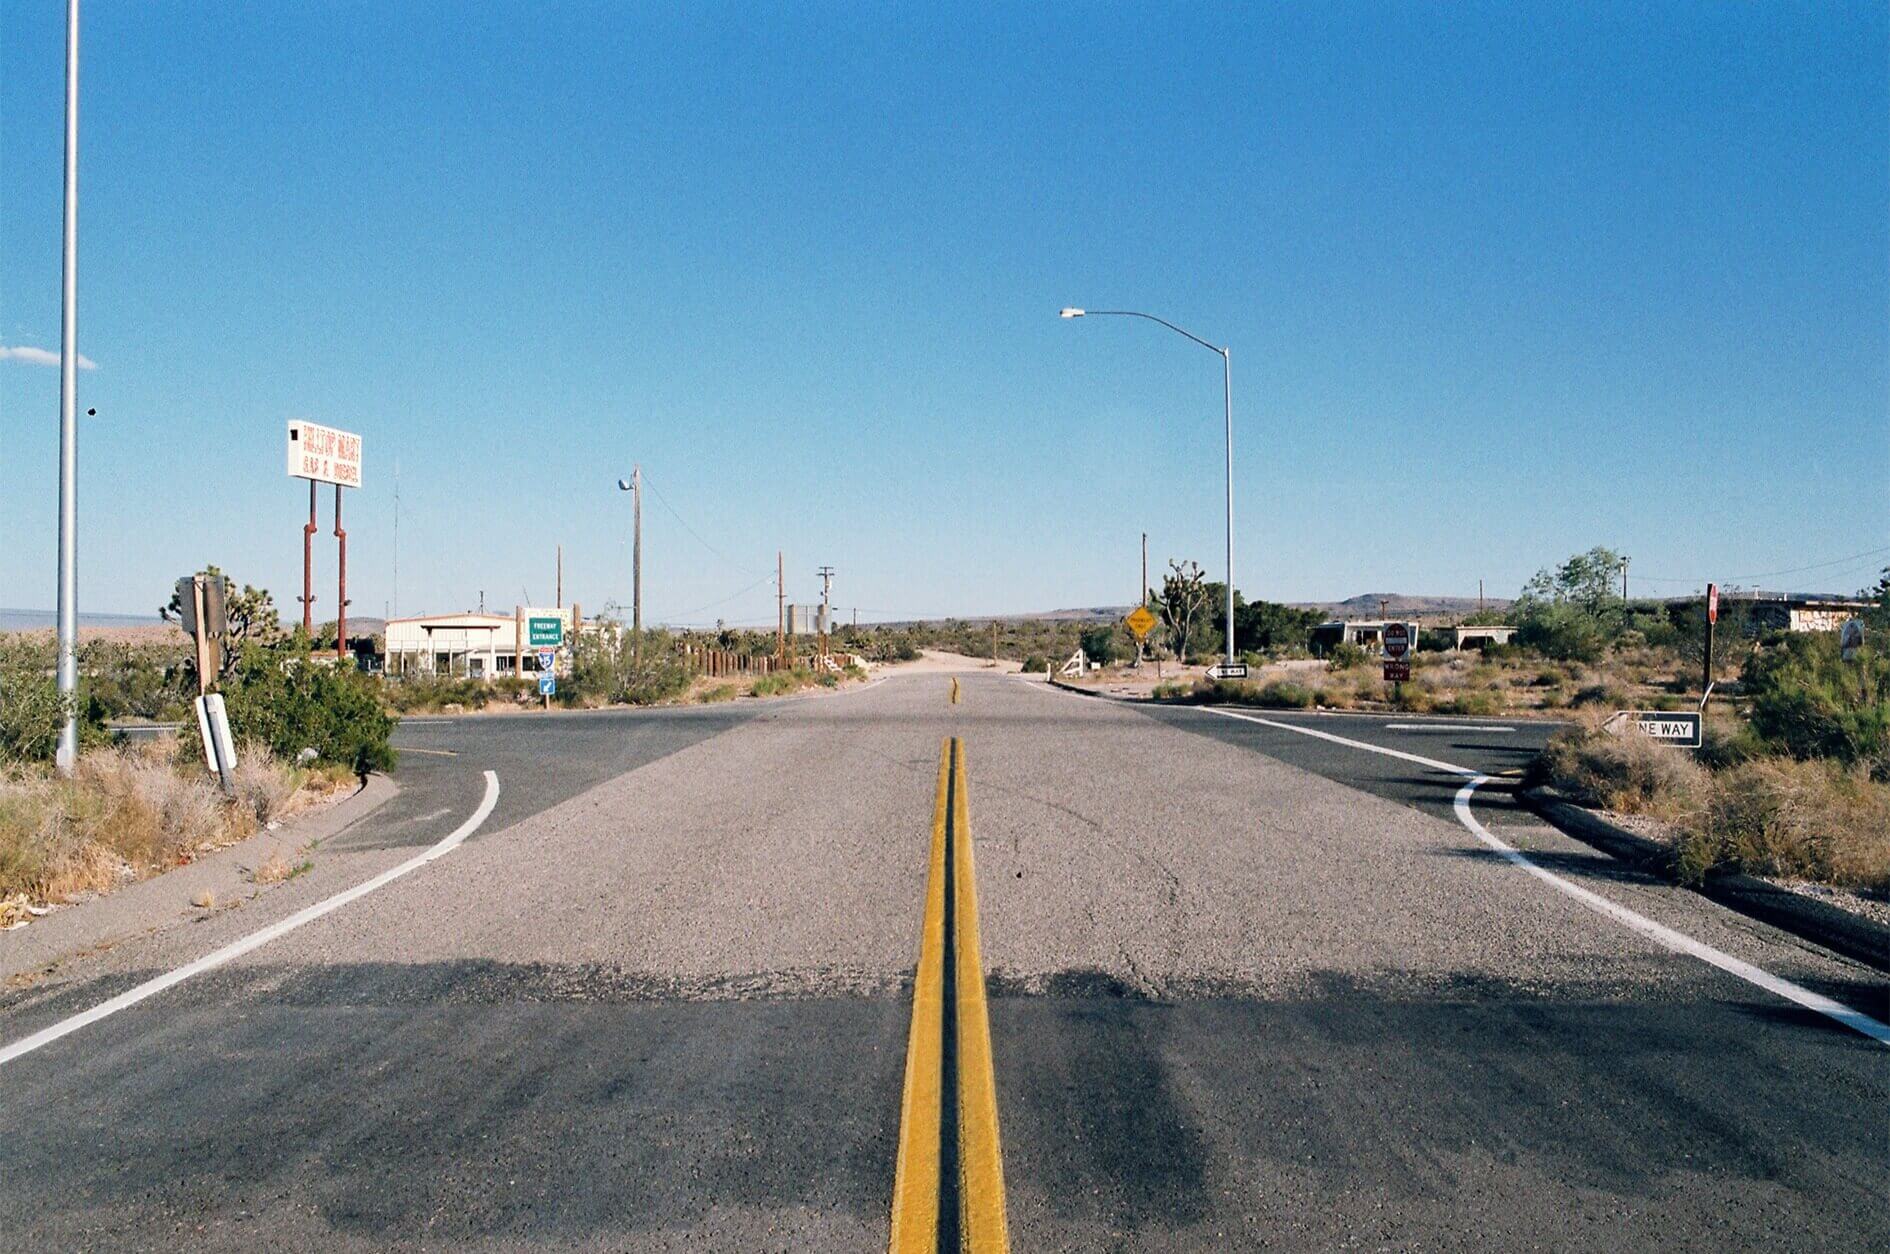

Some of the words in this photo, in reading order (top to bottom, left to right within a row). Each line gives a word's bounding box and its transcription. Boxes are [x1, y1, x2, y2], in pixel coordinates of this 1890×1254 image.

[543, 655, 551, 665] 15
[1638, 722, 1657, 735] NE
[1660, 723, 1689, 735] WAY
